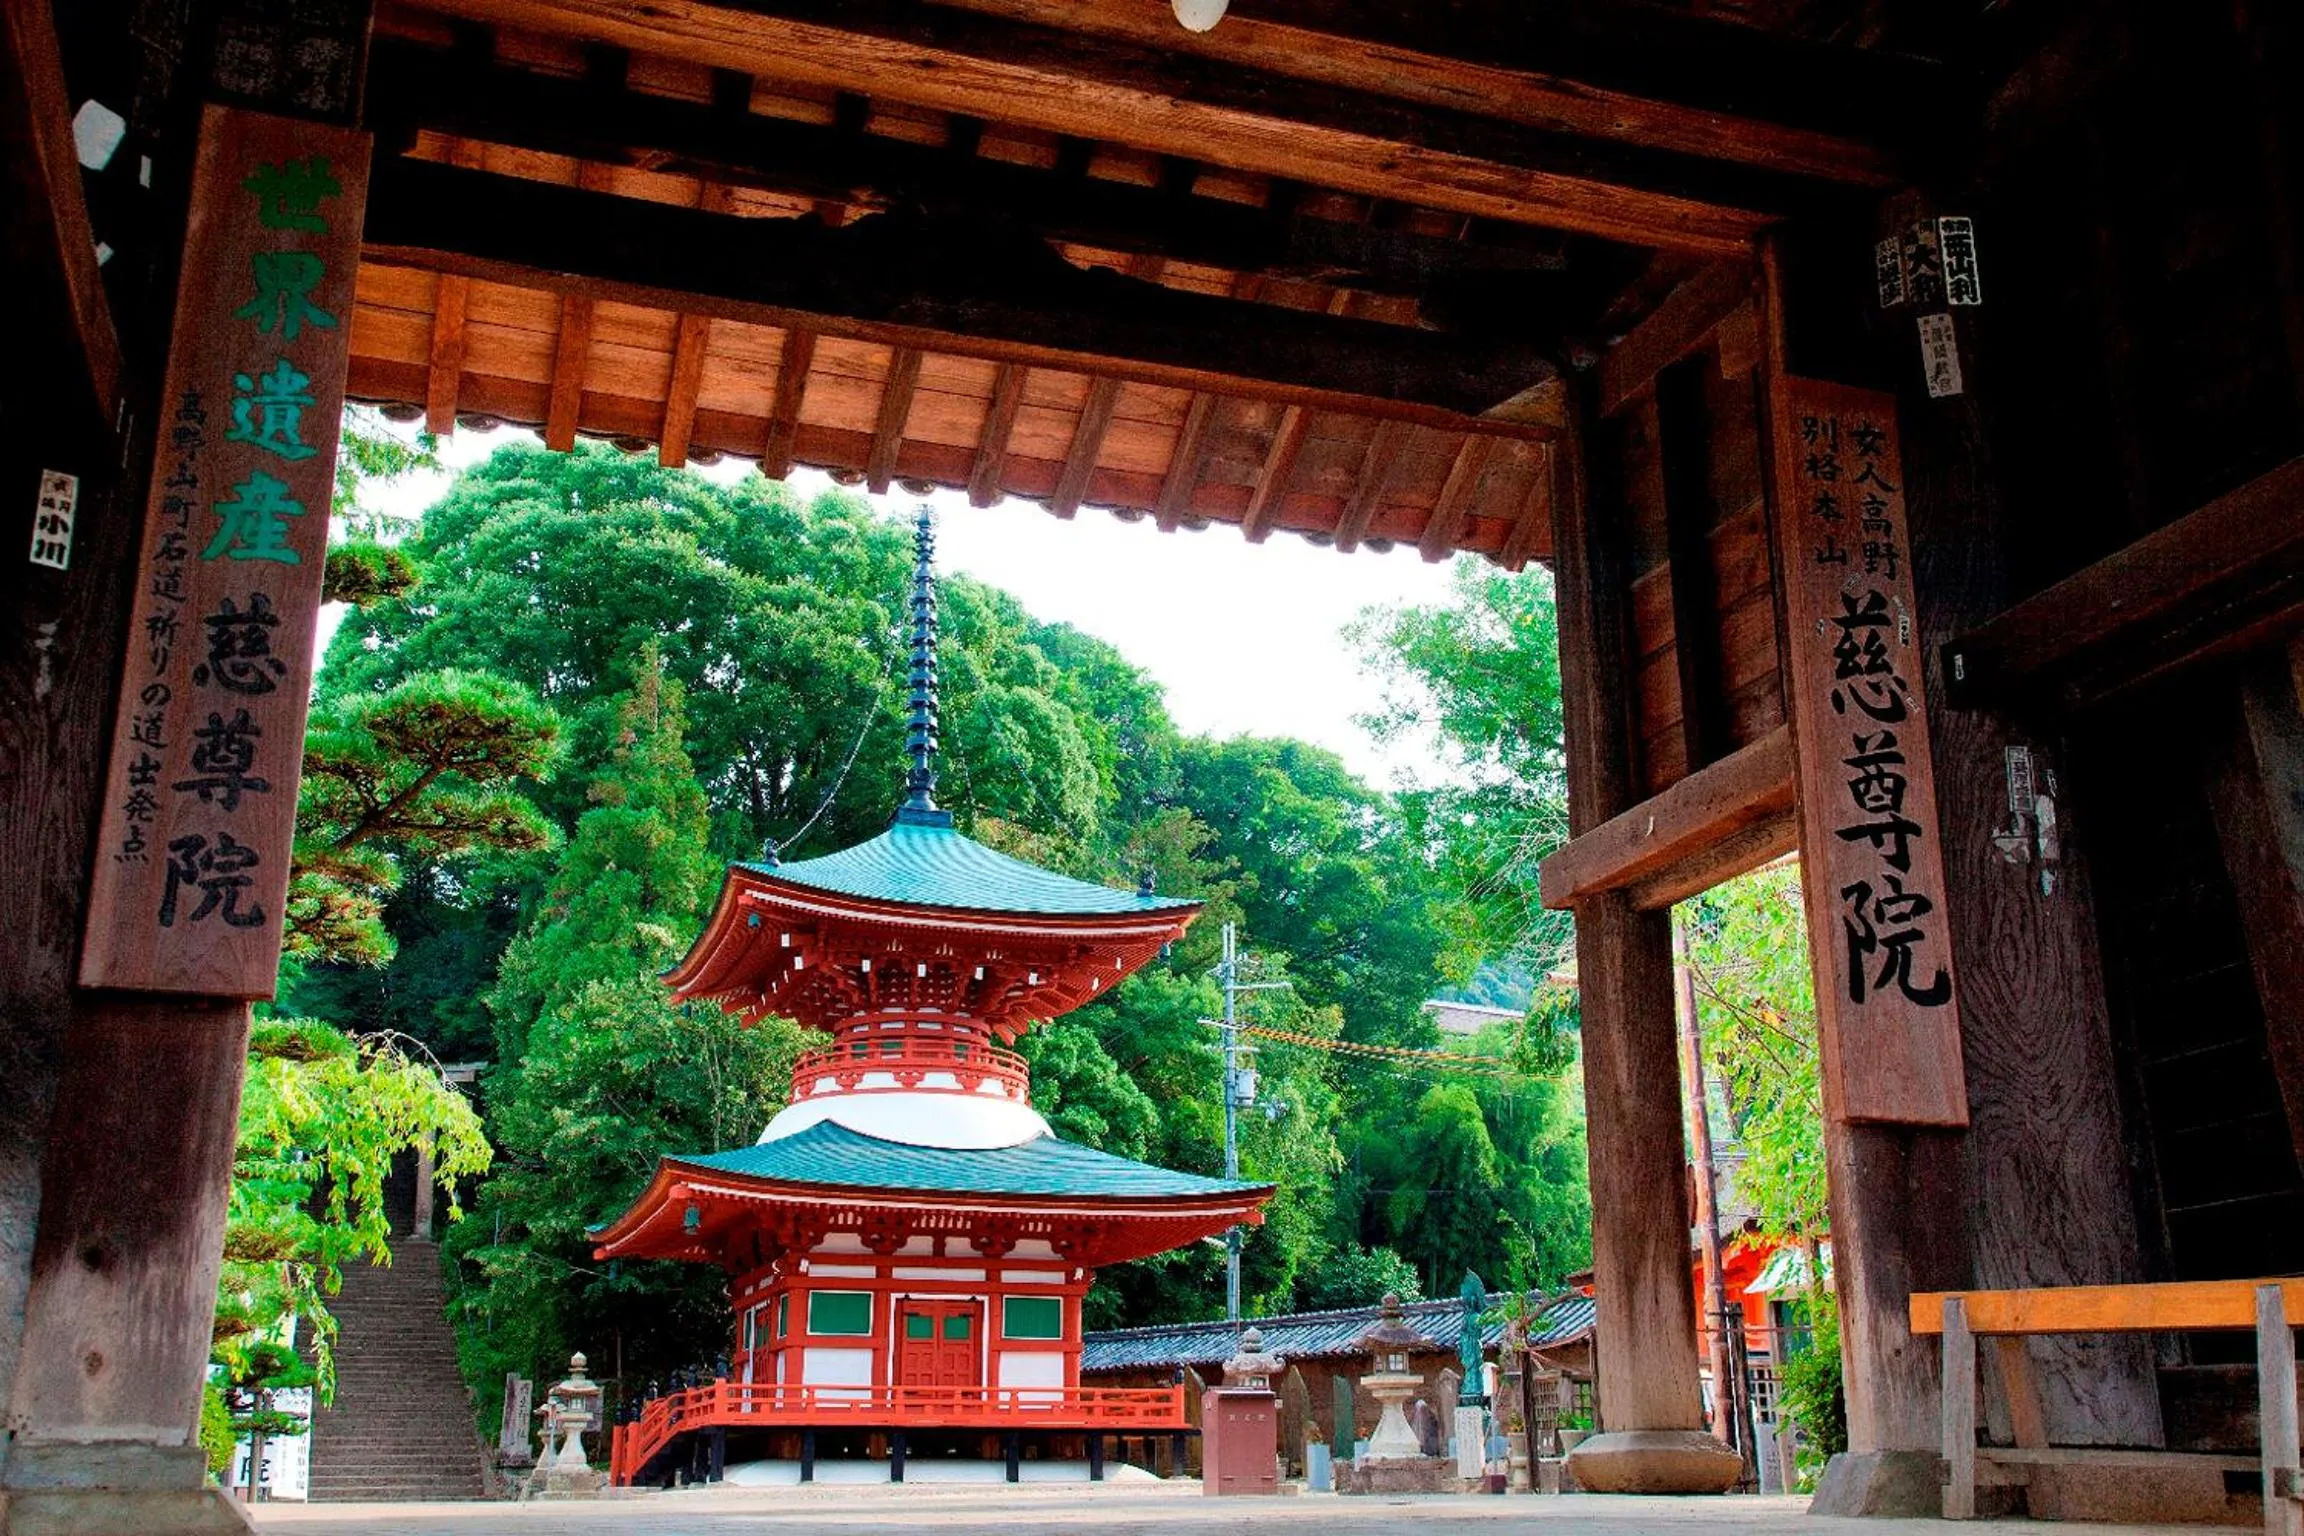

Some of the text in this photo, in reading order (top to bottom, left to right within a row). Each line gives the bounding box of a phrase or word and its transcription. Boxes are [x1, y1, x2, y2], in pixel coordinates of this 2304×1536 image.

[200, 155, 344, 566] 世界遺産
[1803, 416, 1848, 566] 別格本山
[1852, 419, 1901, 582] 女人高野
[157, 592, 288, 929] 慈尊院
[1830, 588, 1952, 1007] 慈尊院
